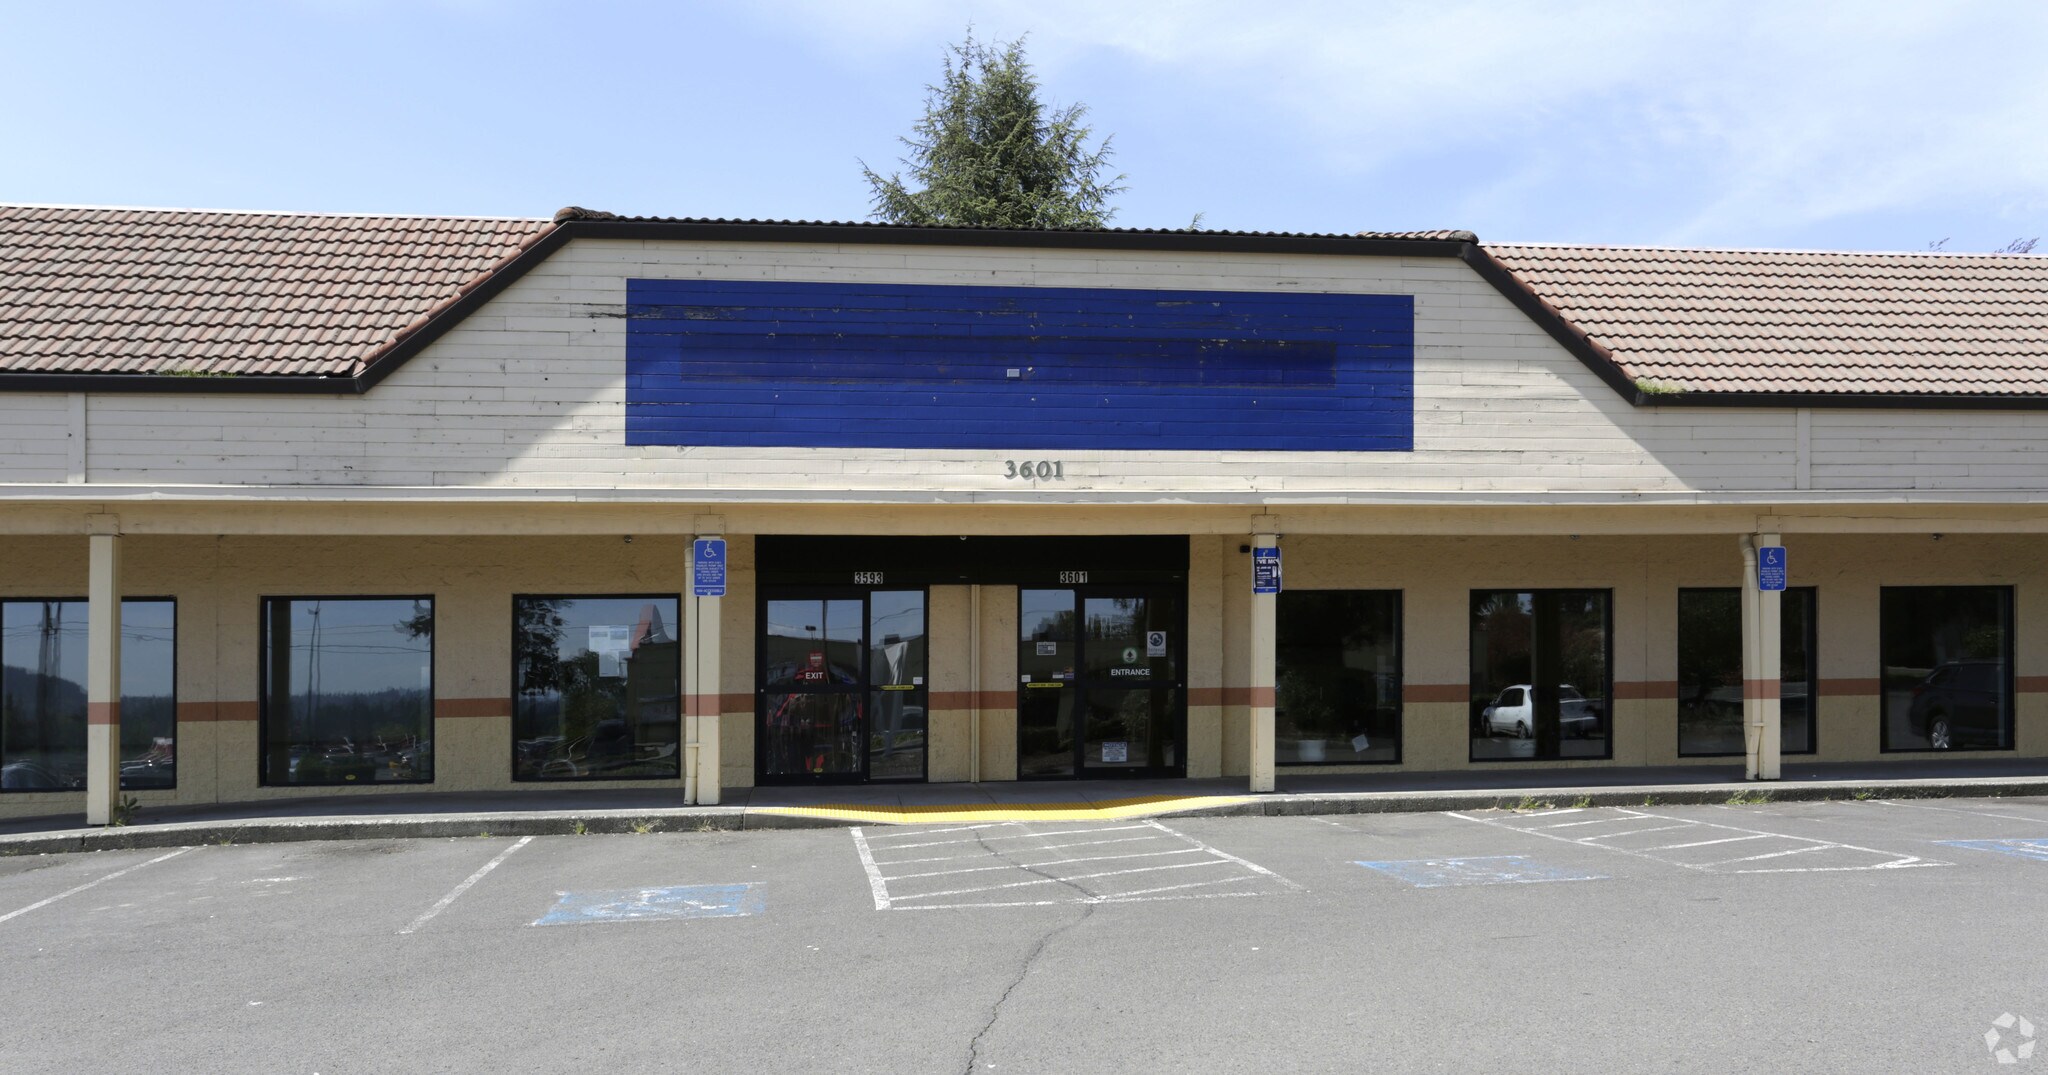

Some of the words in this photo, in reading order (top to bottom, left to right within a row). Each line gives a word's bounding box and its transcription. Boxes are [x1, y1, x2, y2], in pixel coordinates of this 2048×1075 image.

[1004, 460, 1064, 478] 3601
[855, 571, 883, 584] 3593
[1061, 571, 1087, 583] 3601
